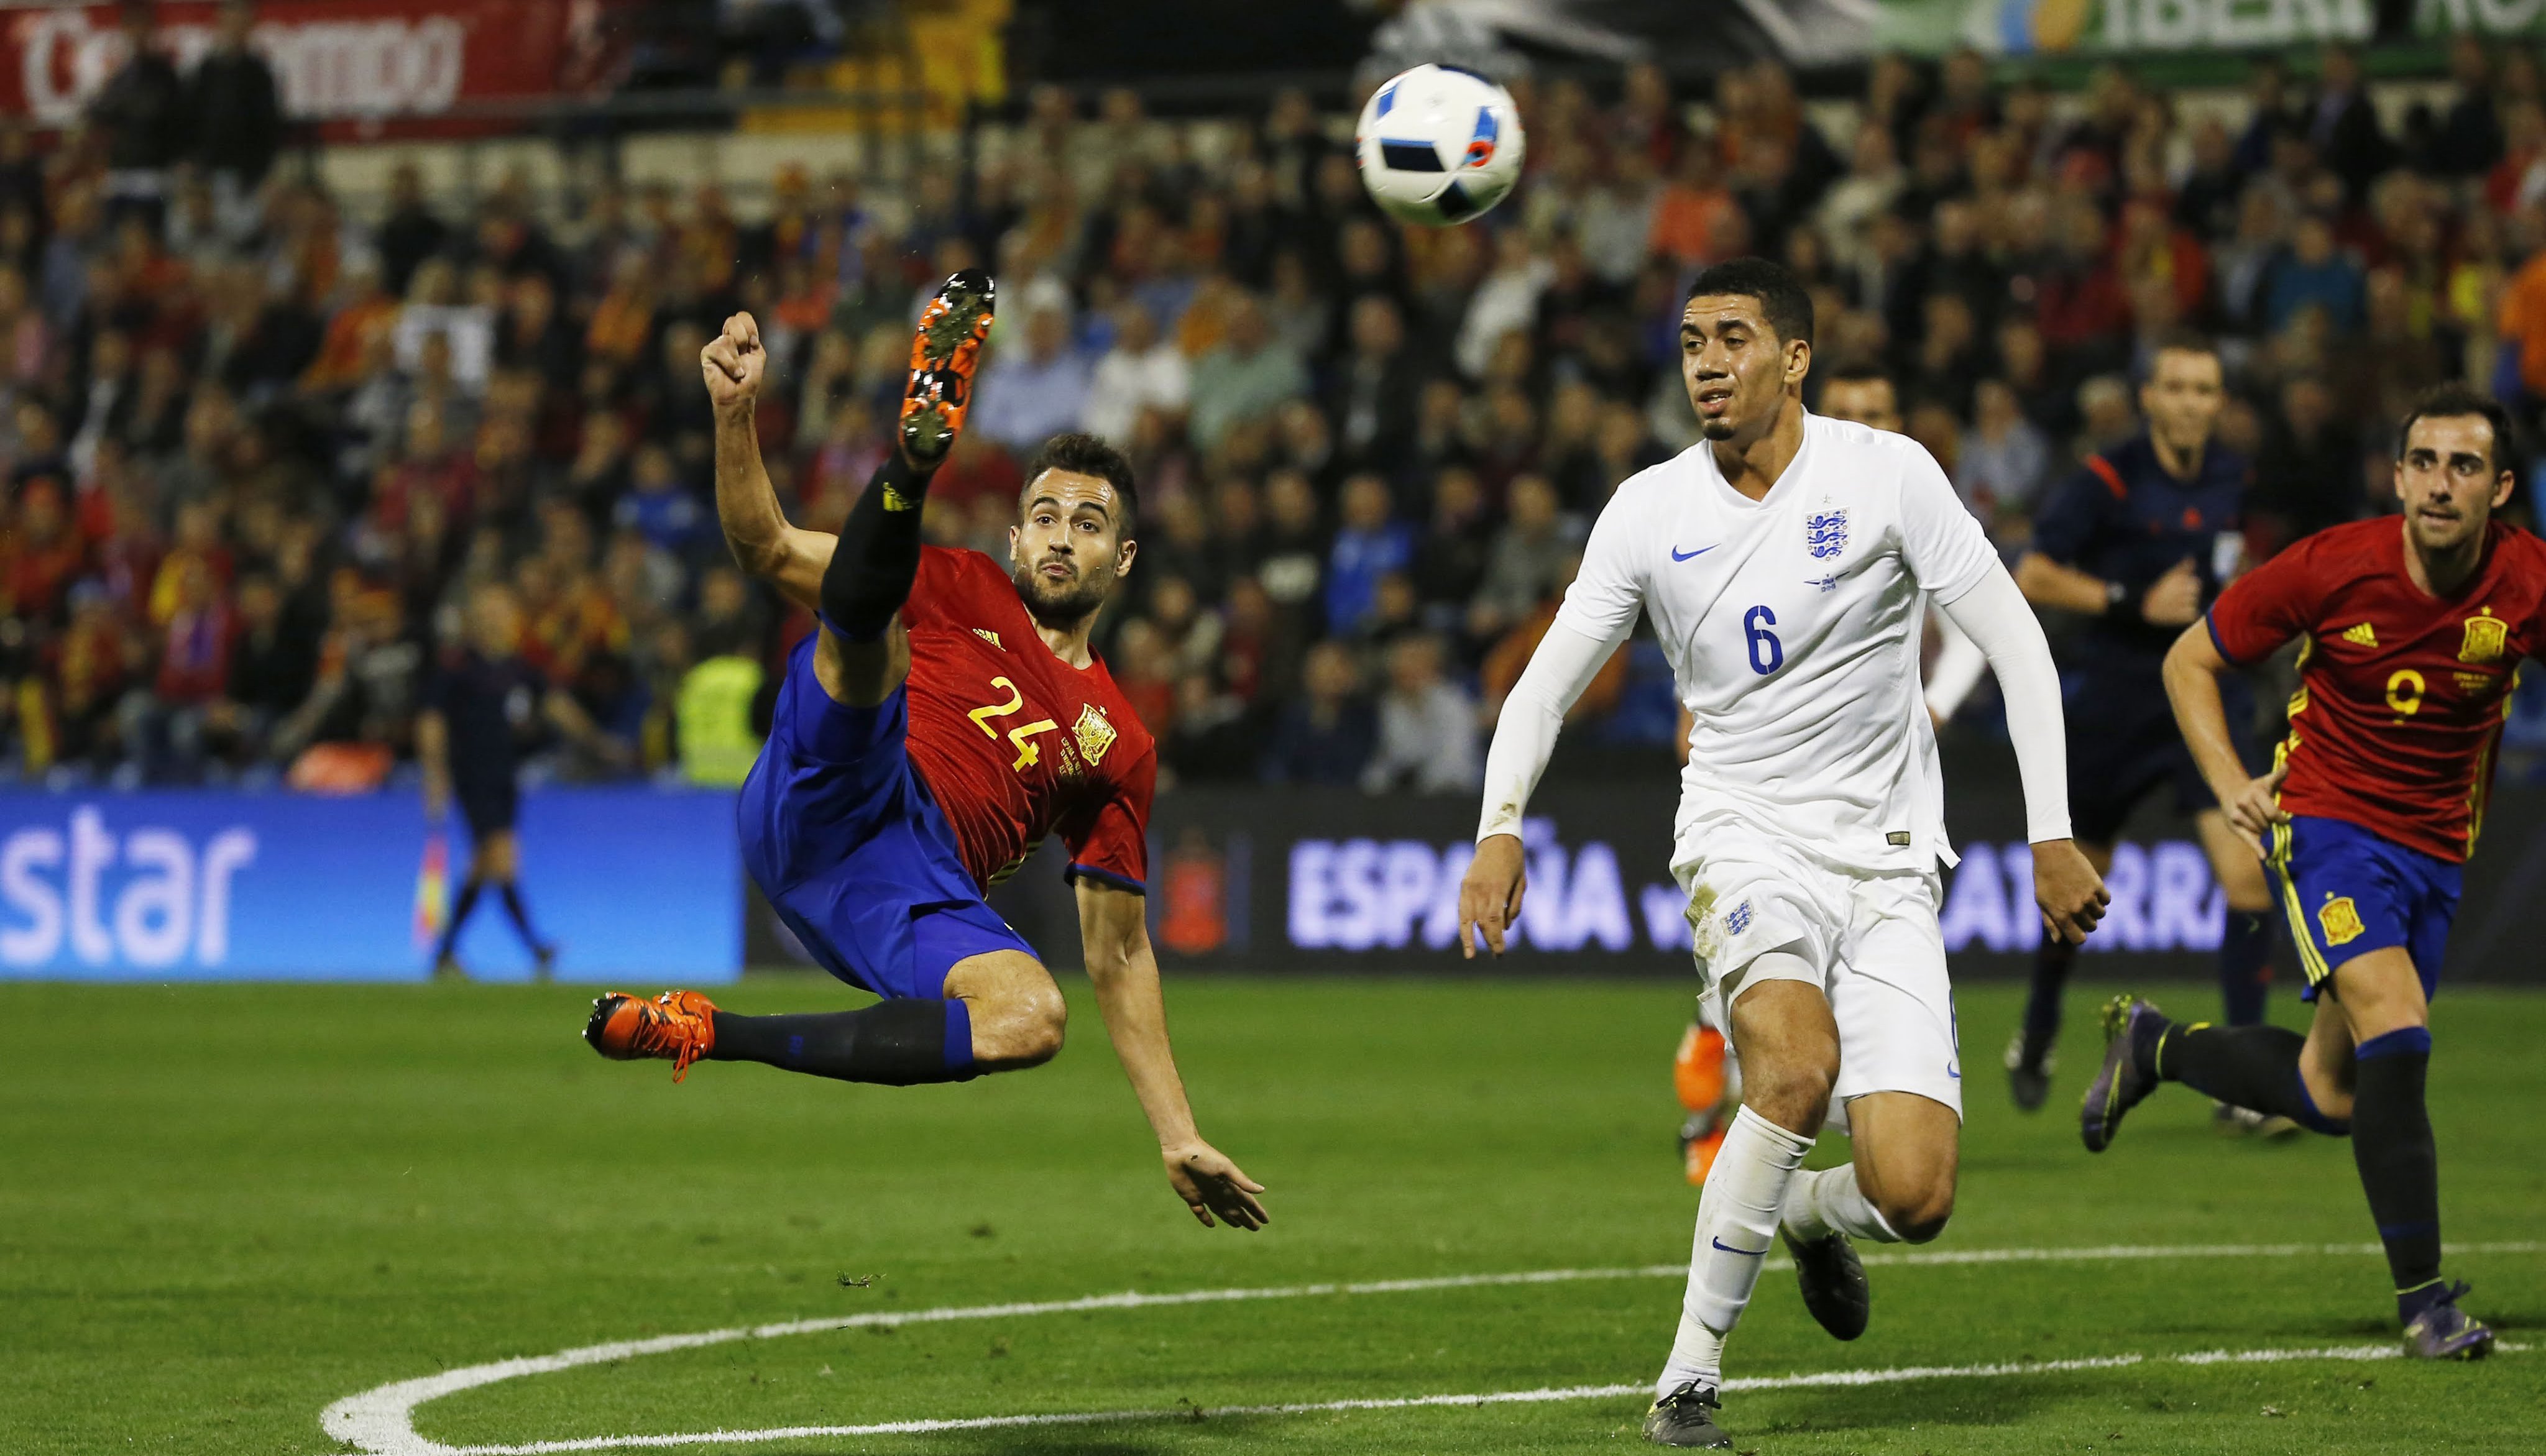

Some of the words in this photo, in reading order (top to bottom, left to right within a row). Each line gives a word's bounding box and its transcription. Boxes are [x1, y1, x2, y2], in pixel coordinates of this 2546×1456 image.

[1744, 605, 1784, 675] 6
[967, 675, 1059, 772] 24
[2385, 668, 2426, 726] 9
[0, 804, 257, 966] star
